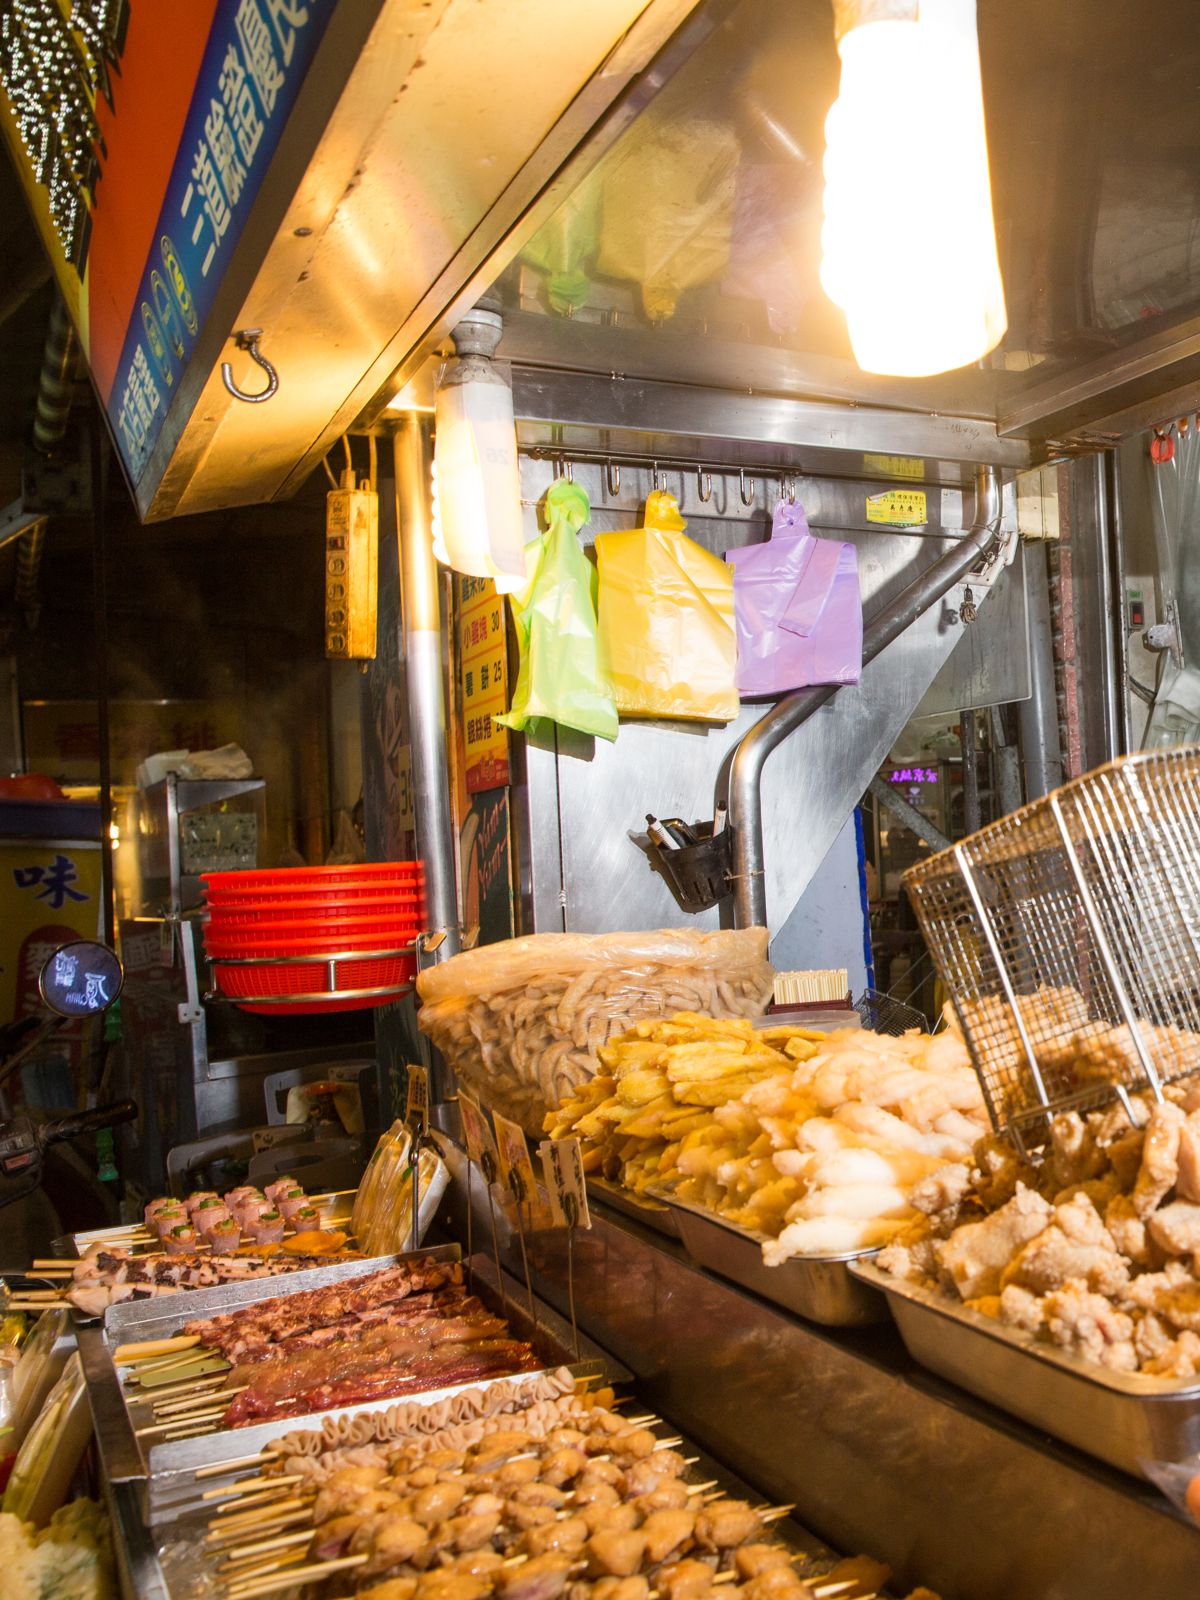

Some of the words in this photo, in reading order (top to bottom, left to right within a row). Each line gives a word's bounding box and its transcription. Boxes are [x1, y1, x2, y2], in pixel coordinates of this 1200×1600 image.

[491, 610, 500, 633] 30
[493, 660, 502, 683] 25
[12, 854, 91, 911] 味
